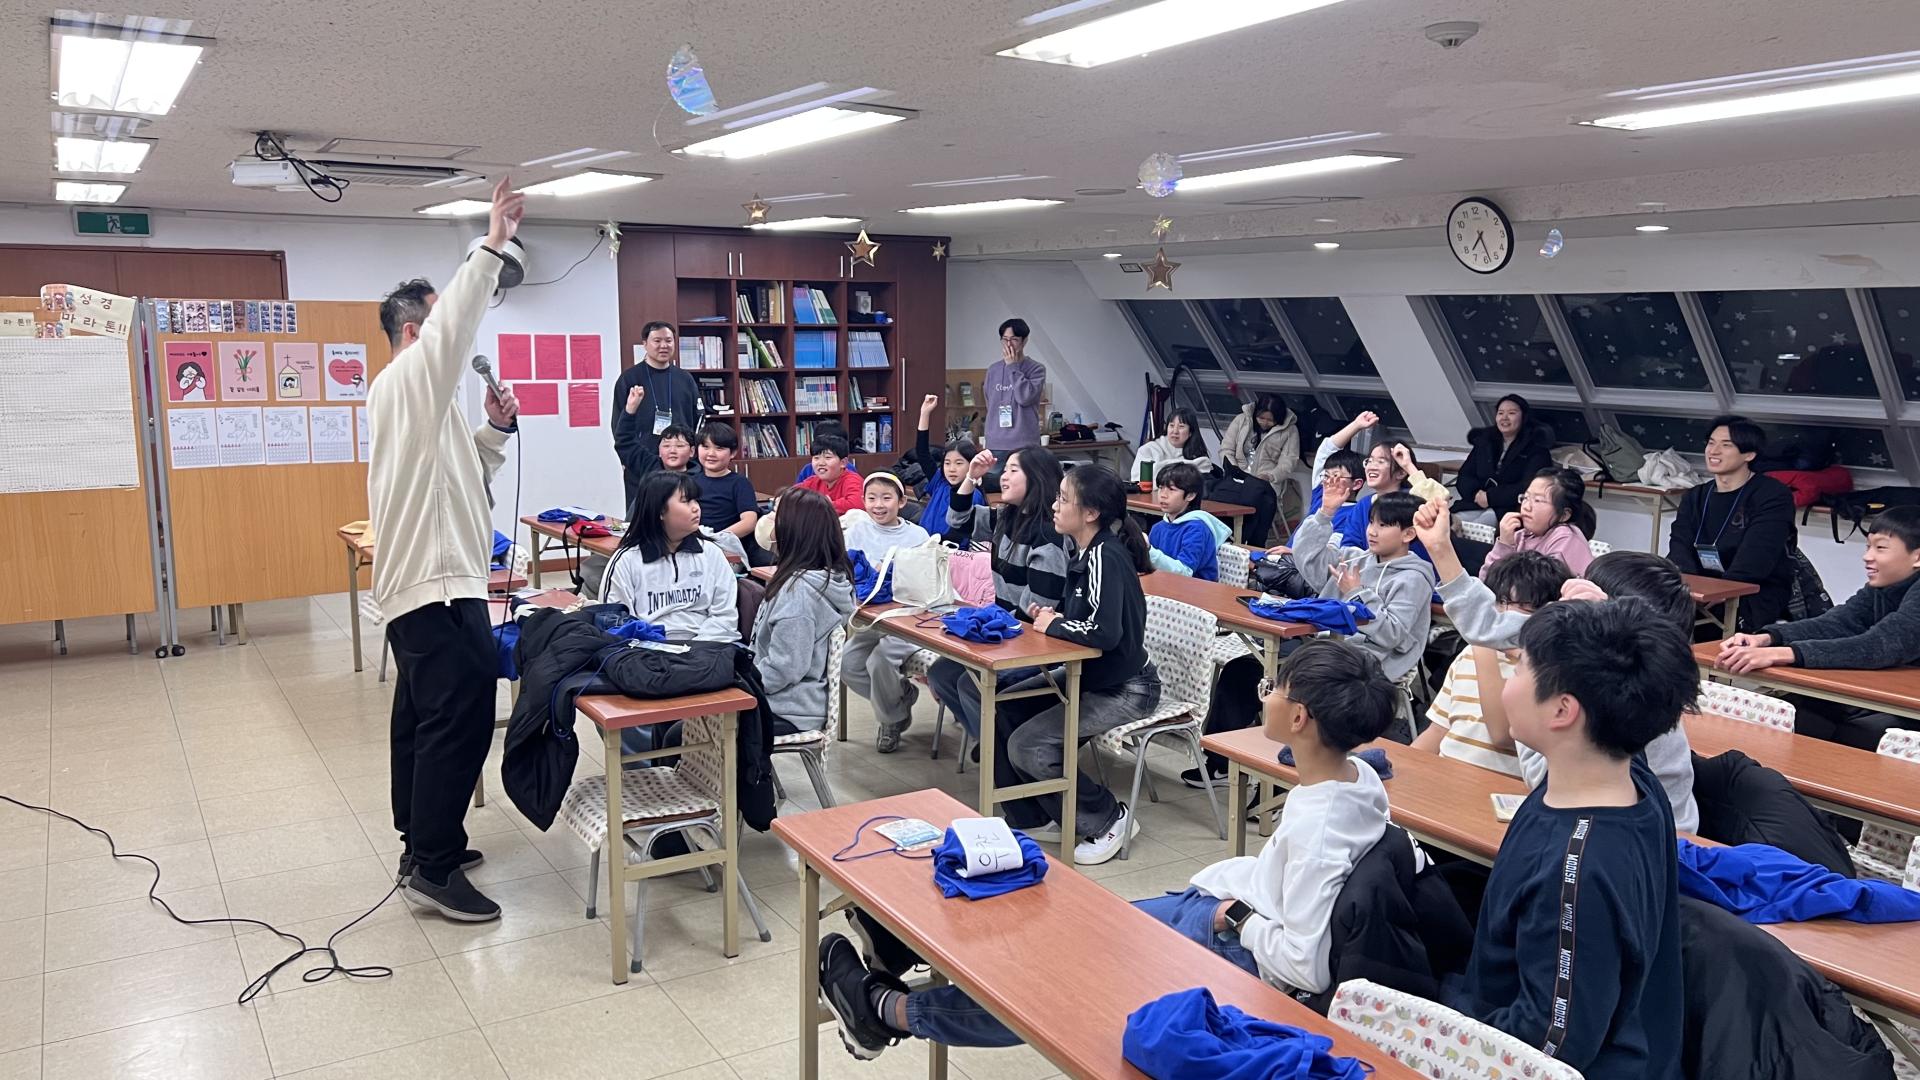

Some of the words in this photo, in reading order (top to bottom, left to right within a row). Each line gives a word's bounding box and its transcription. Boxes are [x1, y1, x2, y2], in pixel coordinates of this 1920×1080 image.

[1471, 206, 1479, 215] 12
[1485, 209, 1489, 217] 1
[1462, 211, 1468, 219] 11
[1457, 221, 1465, 229] 10
[1493, 217, 1499, 226] 2
[1457, 233, 1462, 241] 9
[1500, 230, 1505, 238] 3
[1463, 246, 1469, 254] 8
[1473, 254, 1477, 262] 7
[1483, 256, 1489, 264] 6
[1493, 252, 1499, 260] 5
[1572, 819, 1590, 840] MODISH
[1565, 853, 1579, 884] MODISH
[1561, 902, 1573, 932] MODISH
[1559, 948, 1572, 980] MODISH
[1553, 996, 1567, 1029] MODISH
